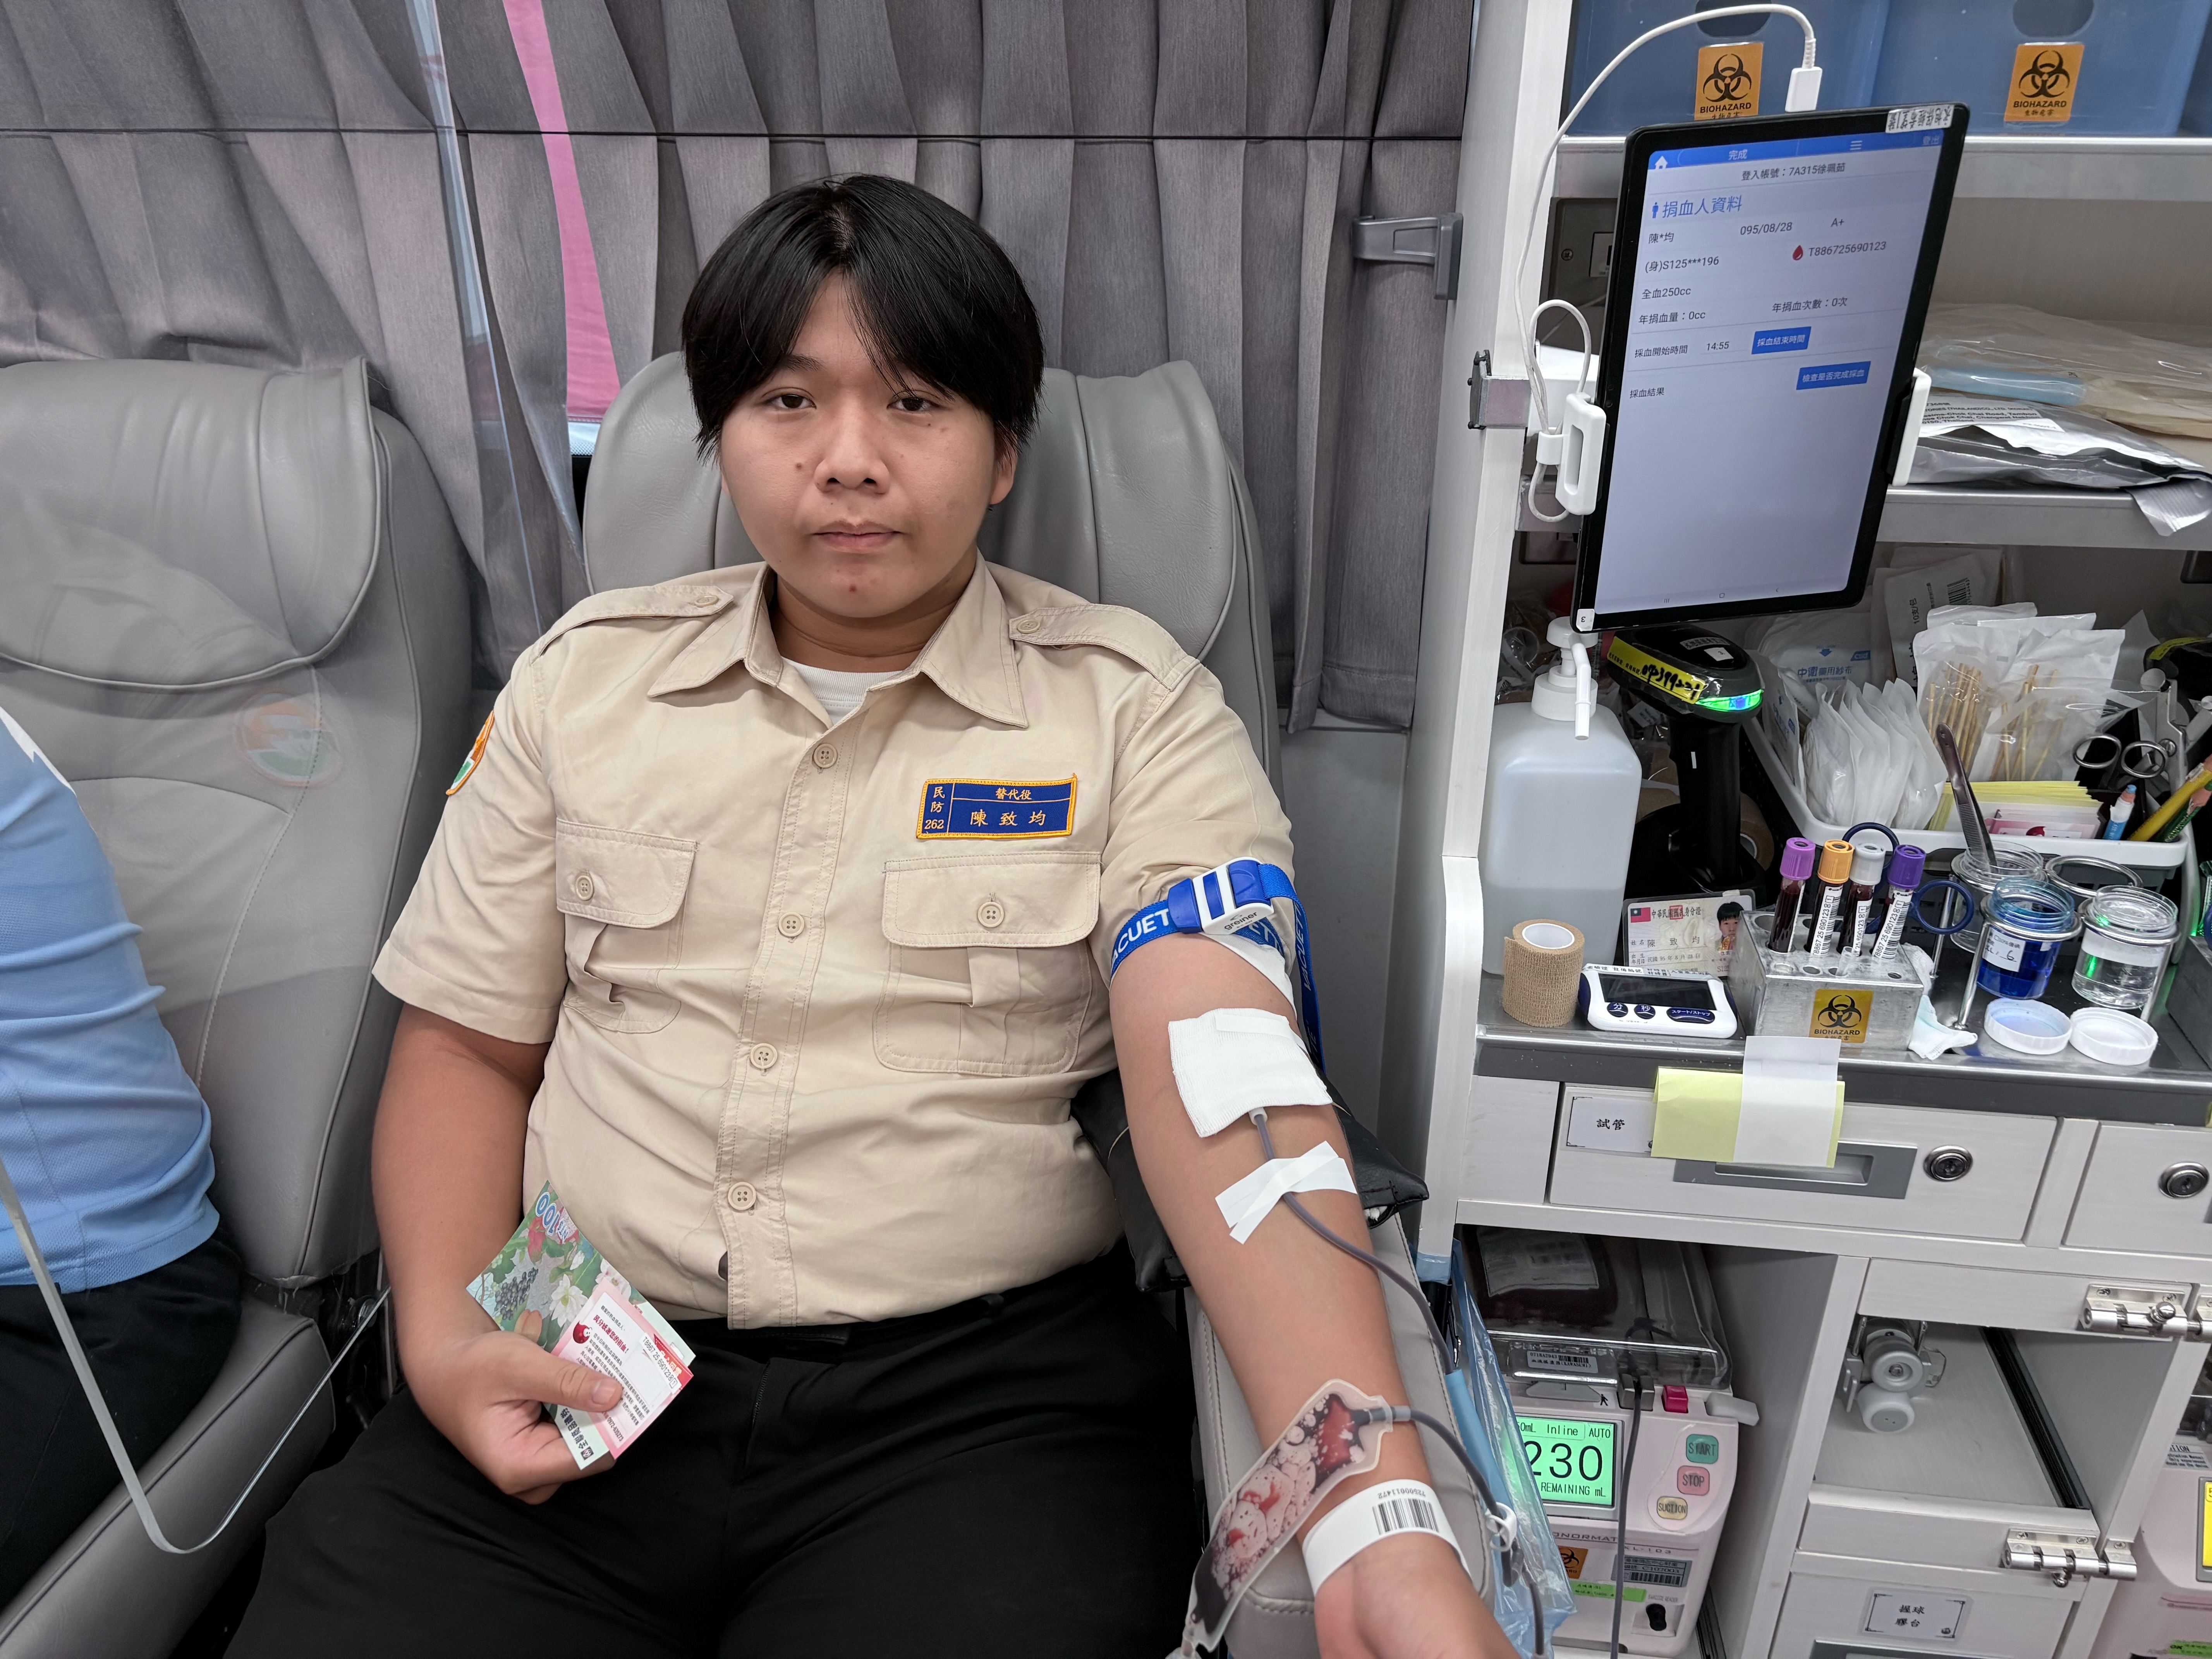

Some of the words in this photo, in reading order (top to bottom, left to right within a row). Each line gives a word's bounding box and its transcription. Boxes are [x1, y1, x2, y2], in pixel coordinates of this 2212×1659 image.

[1700, 103, 1751, 113] BIOHAZARD
[1728, 149, 1747, 160] 完成
[1662, 195, 1743, 219] 捐血人資料
[1740, 222, 1793, 236] 095/08/28
[1831, 217, 1845, 228] A+
[1808, 240, 1887, 258] T886725690123
[1642, 286, 1692, 300] 全血250cc
[1757, 334, 1805, 347] 採血結束時間
[1634, 345, 1688, 358] 採血開始時間
[1706, 341, 1729, 351] 14:55
[1802, 369, 1865, 383] 檢查是否完成採血
[1629, 387, 1664, 399] 採血結果
[996, 788, 1032, 800] 替代役
[924, 819, 944, 830] 262
[1224, 911, 1258, 930] greiner
[1112, 909, 1169, 963] ACUET
[1817, 931, 1824, 940] 25
[1881, 934, 1888, 943] 25
[1295, 904, 1312, 991] VACUETT
[1596, 1118, 1626, 1130] 試管
[641, 1336, 656, 1354] T8867
[652, 1352, 660, 1361] 25
[558, 1407, 589, 1450] 全聯商品禮券
[1517, 1422, 1536, 1433] 0mL
[1547, 1424, 1578, 1436] Inline
[1589, 1428, 1611, 1438] AUTO
[1688, 1442, 1716, 1456] START
[1525, 1441, 1602, 1481] 230
[1682, 1474, 1704, 1487] STOP
[1378, 1488, 1426, 1498] 72500011472
[1541, 1482, 1590, 1496] REMAINING
[1595, 1487, 1606, 1497] mL
[1658, 1503, 1686, 1514] SUCTION
[1553, 1532, 1618, 1542] ONORMAT
